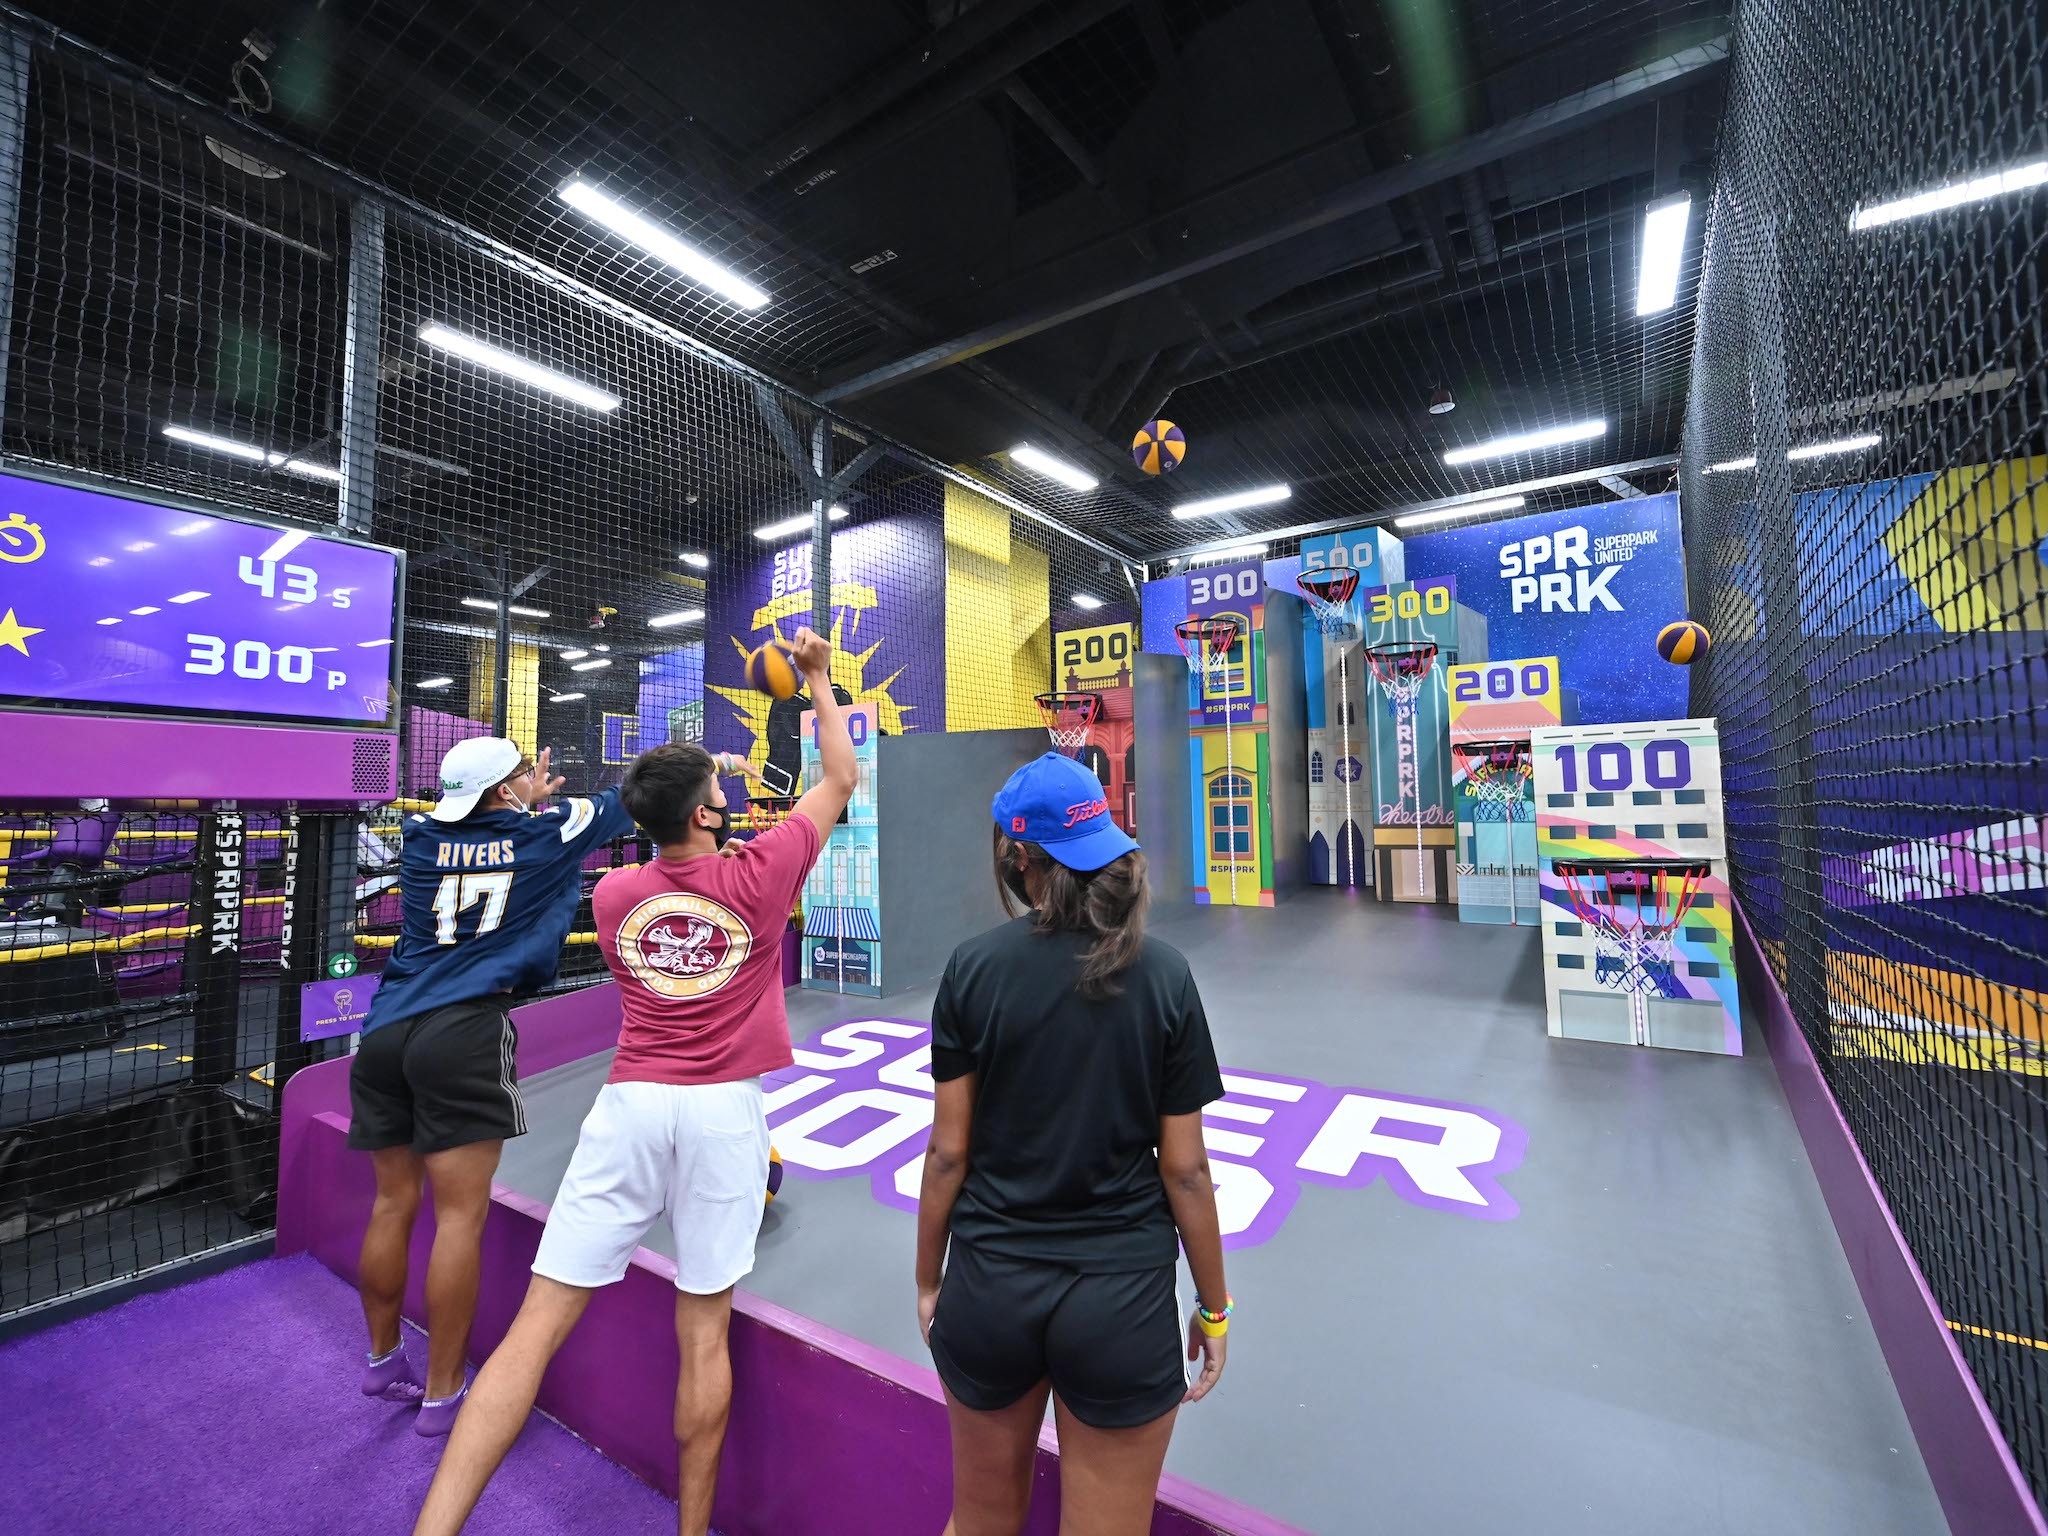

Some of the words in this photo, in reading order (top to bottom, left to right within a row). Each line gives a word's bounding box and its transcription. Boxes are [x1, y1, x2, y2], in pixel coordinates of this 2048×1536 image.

[1499, 525, 1593, 579] SPR
[1593, 529, 1659, 551] SUPERPARK
[1306, 542, 1373, 576] 500
[238, 555, 319, 604] 43
[1190, 569, 1258, 605] 300
[1511, 564, 1626, 613] PRK
[1370, 585, 1450, 624] 300
[184, 633, 314, 684] 300
[1063, 632, 1128, 667] 200
[1455, 664, 1550, 702] 200
[1205, 702, 1250, 714] #SPPRK
[811, 712, 868, 750] 10
[1555, 739, 1692, 792] 100
[1012, 816, 1026, 833] FJ
[436, 839, 515, 867] RIVERS
[1210, 865, 1255, 873] #SPPRK
[431, 871, 514, 945] 17
[316, 1017, 337, 1026] PRESS
[348, 1012, 368, 1021] START
